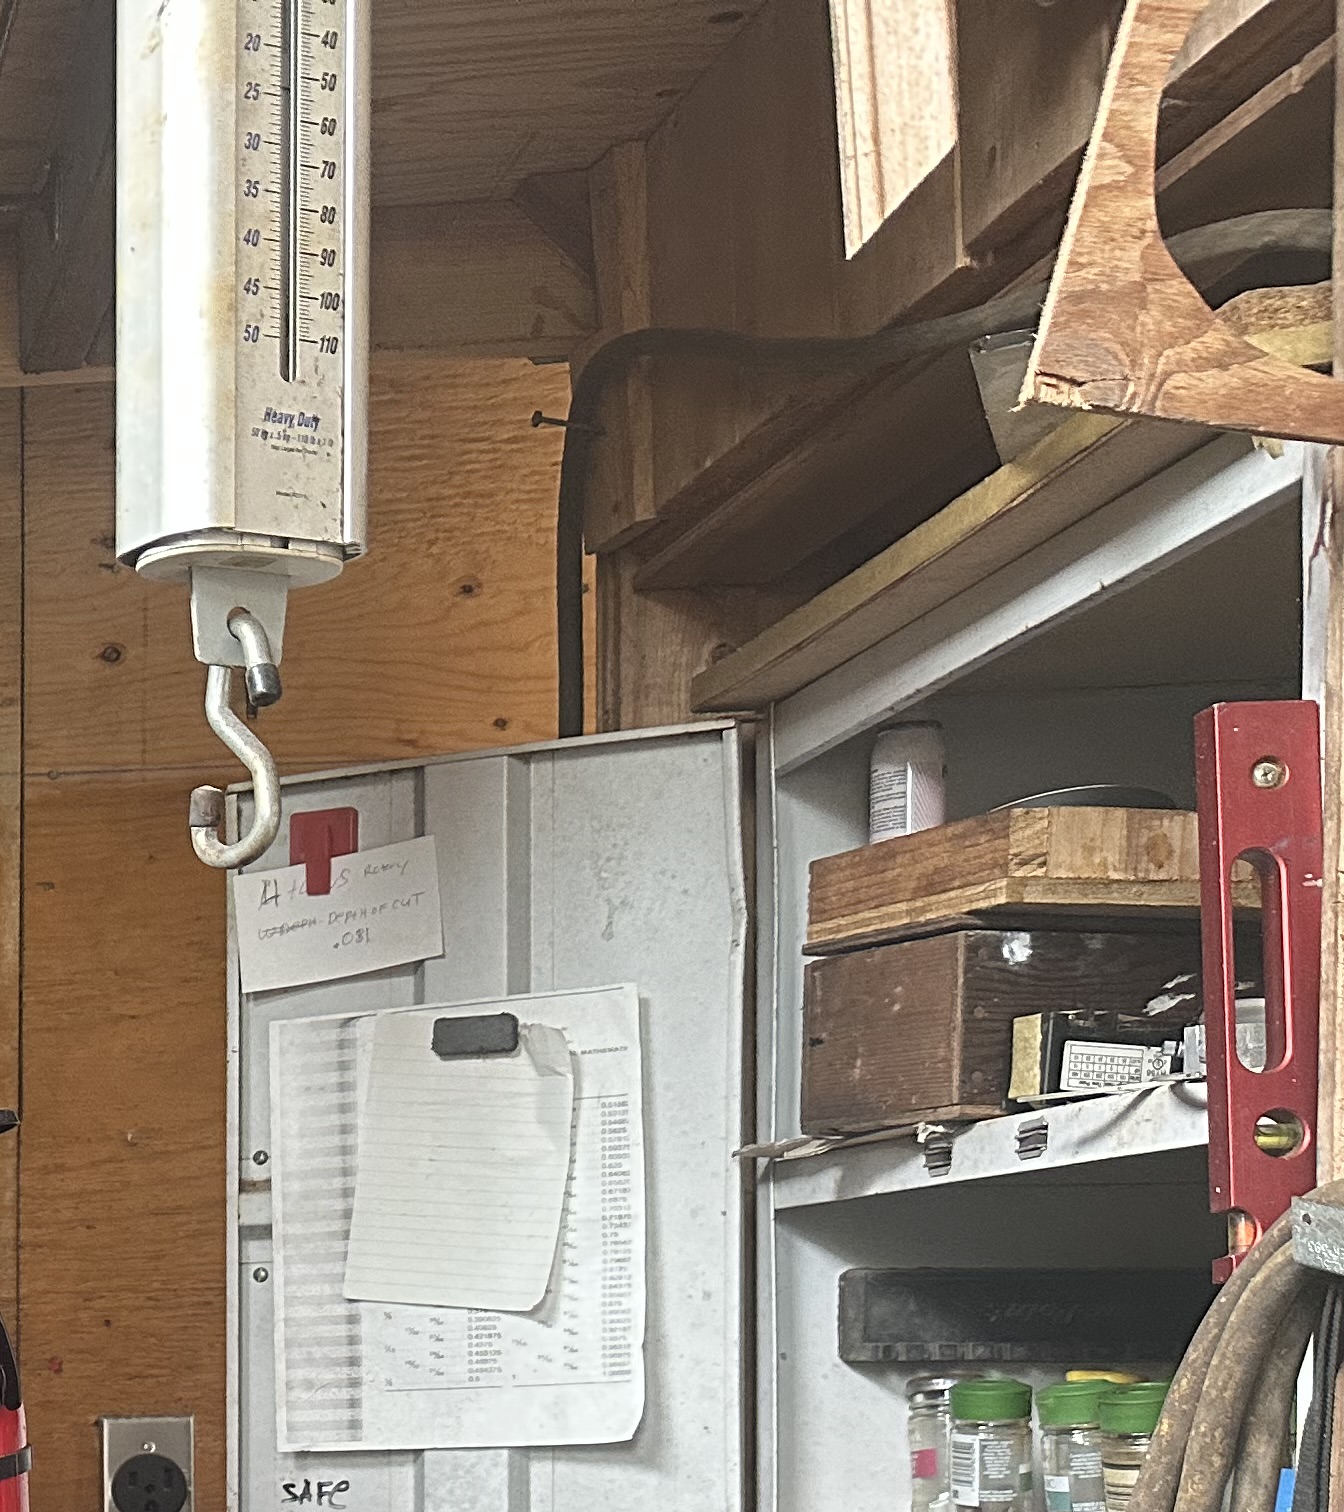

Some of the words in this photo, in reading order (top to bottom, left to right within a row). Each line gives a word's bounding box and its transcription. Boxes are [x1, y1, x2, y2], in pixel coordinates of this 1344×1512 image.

[244, 33, 261, 51] 20
[320, 30, 339, 49] 40
[244, 82, 261, 100] 25
[320, 72, 337, 91] 50
[320, 117, 337, 136] 60
[244, 132, 261, 150] 30
[320, 160, 337, 179] 70
[243, 180, 260, 198] 35
[319, 205, 336, 225] 80
[243, 228, 261, 247] 40
[319, 248, 336, 267] 90
[243, 277, 261, 296] 45
[319, 292, 340, 311] 100
[243, 324, 260, 343] 50
[319, 335, 339, 355] 110
[263, 406, 295, 428] Heavy
[297, 411, 321, 432] Duty
